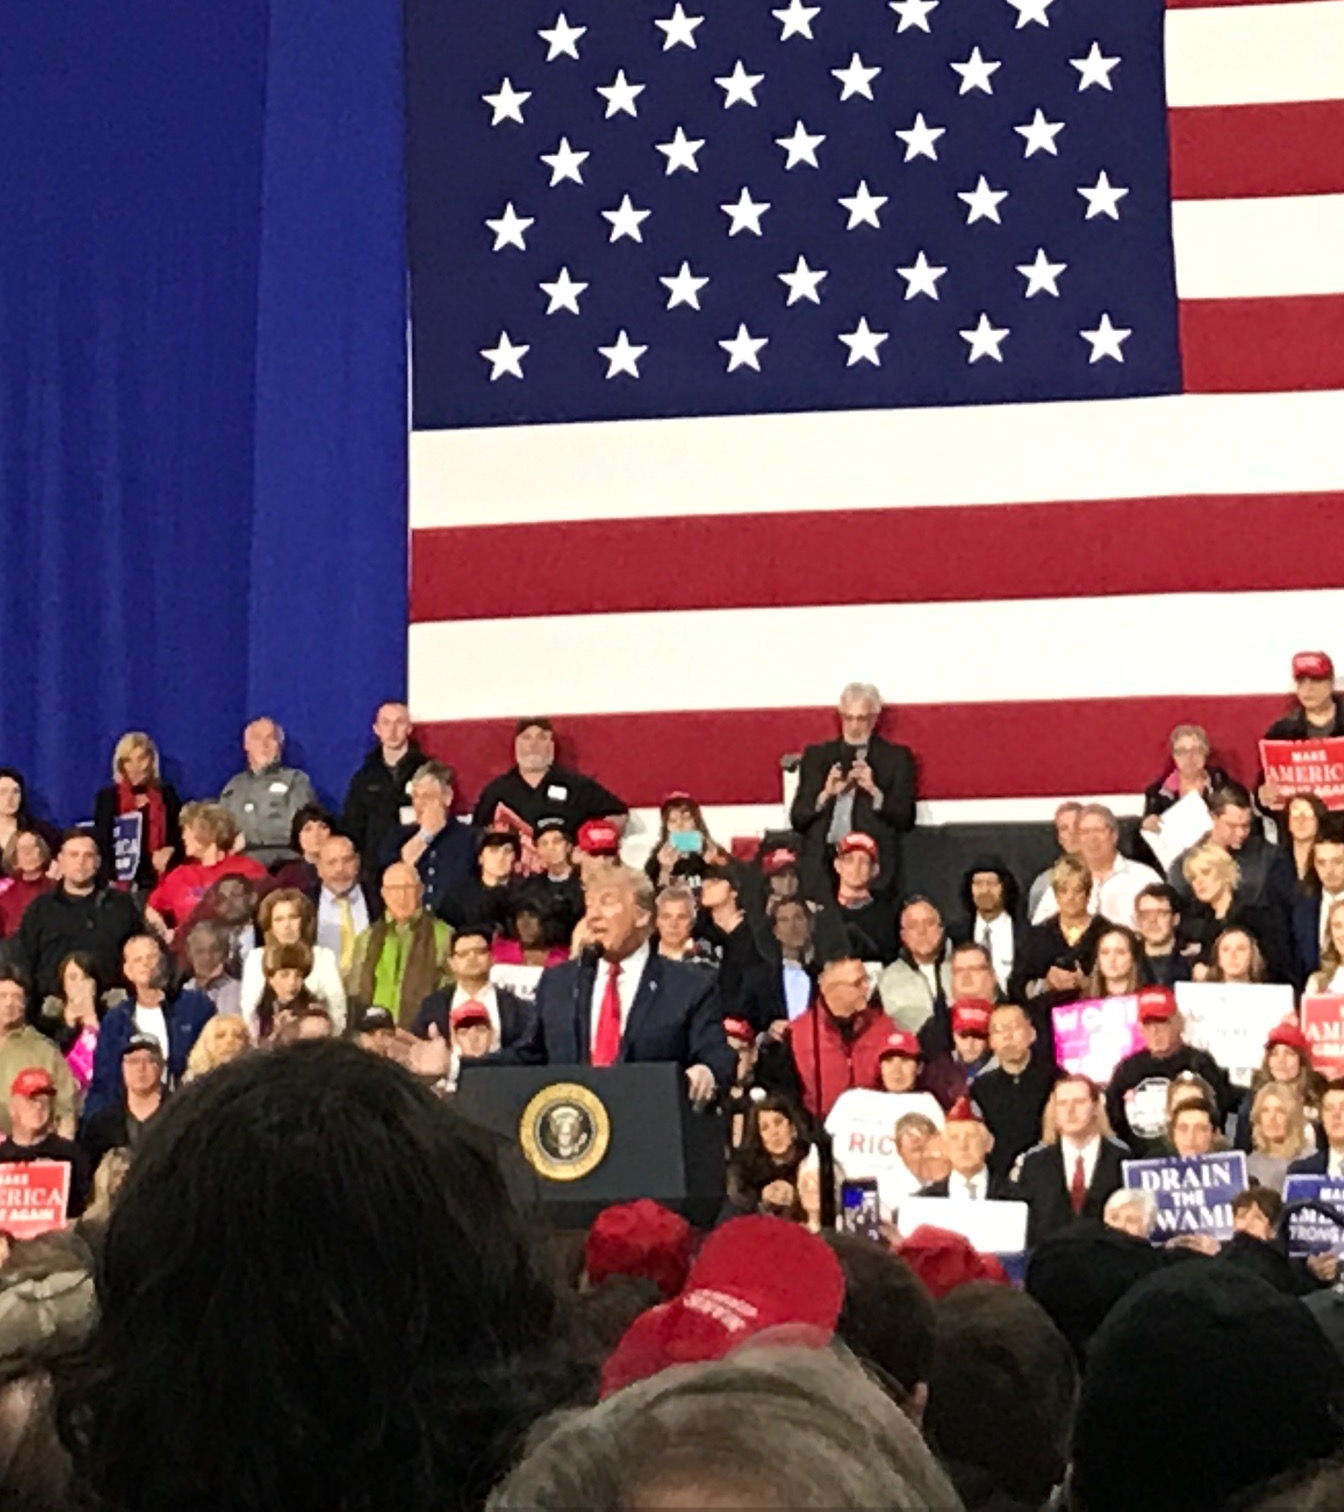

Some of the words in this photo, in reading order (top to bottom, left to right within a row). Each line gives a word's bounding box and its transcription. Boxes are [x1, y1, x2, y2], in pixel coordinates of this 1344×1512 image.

[1291, 750, 1327, 762] MAKE
[849, 1132, 894, 1157] RIC
[1141, 1162, 1233, 1193] DRAIN
[1172, 1189, 1205, 1208] THE
[10, 1208, 55, 1221] AGAIN
[1156, 1203, 1234, 1231] WAM
[1289, 1225, 1340, 1242] TRONG
